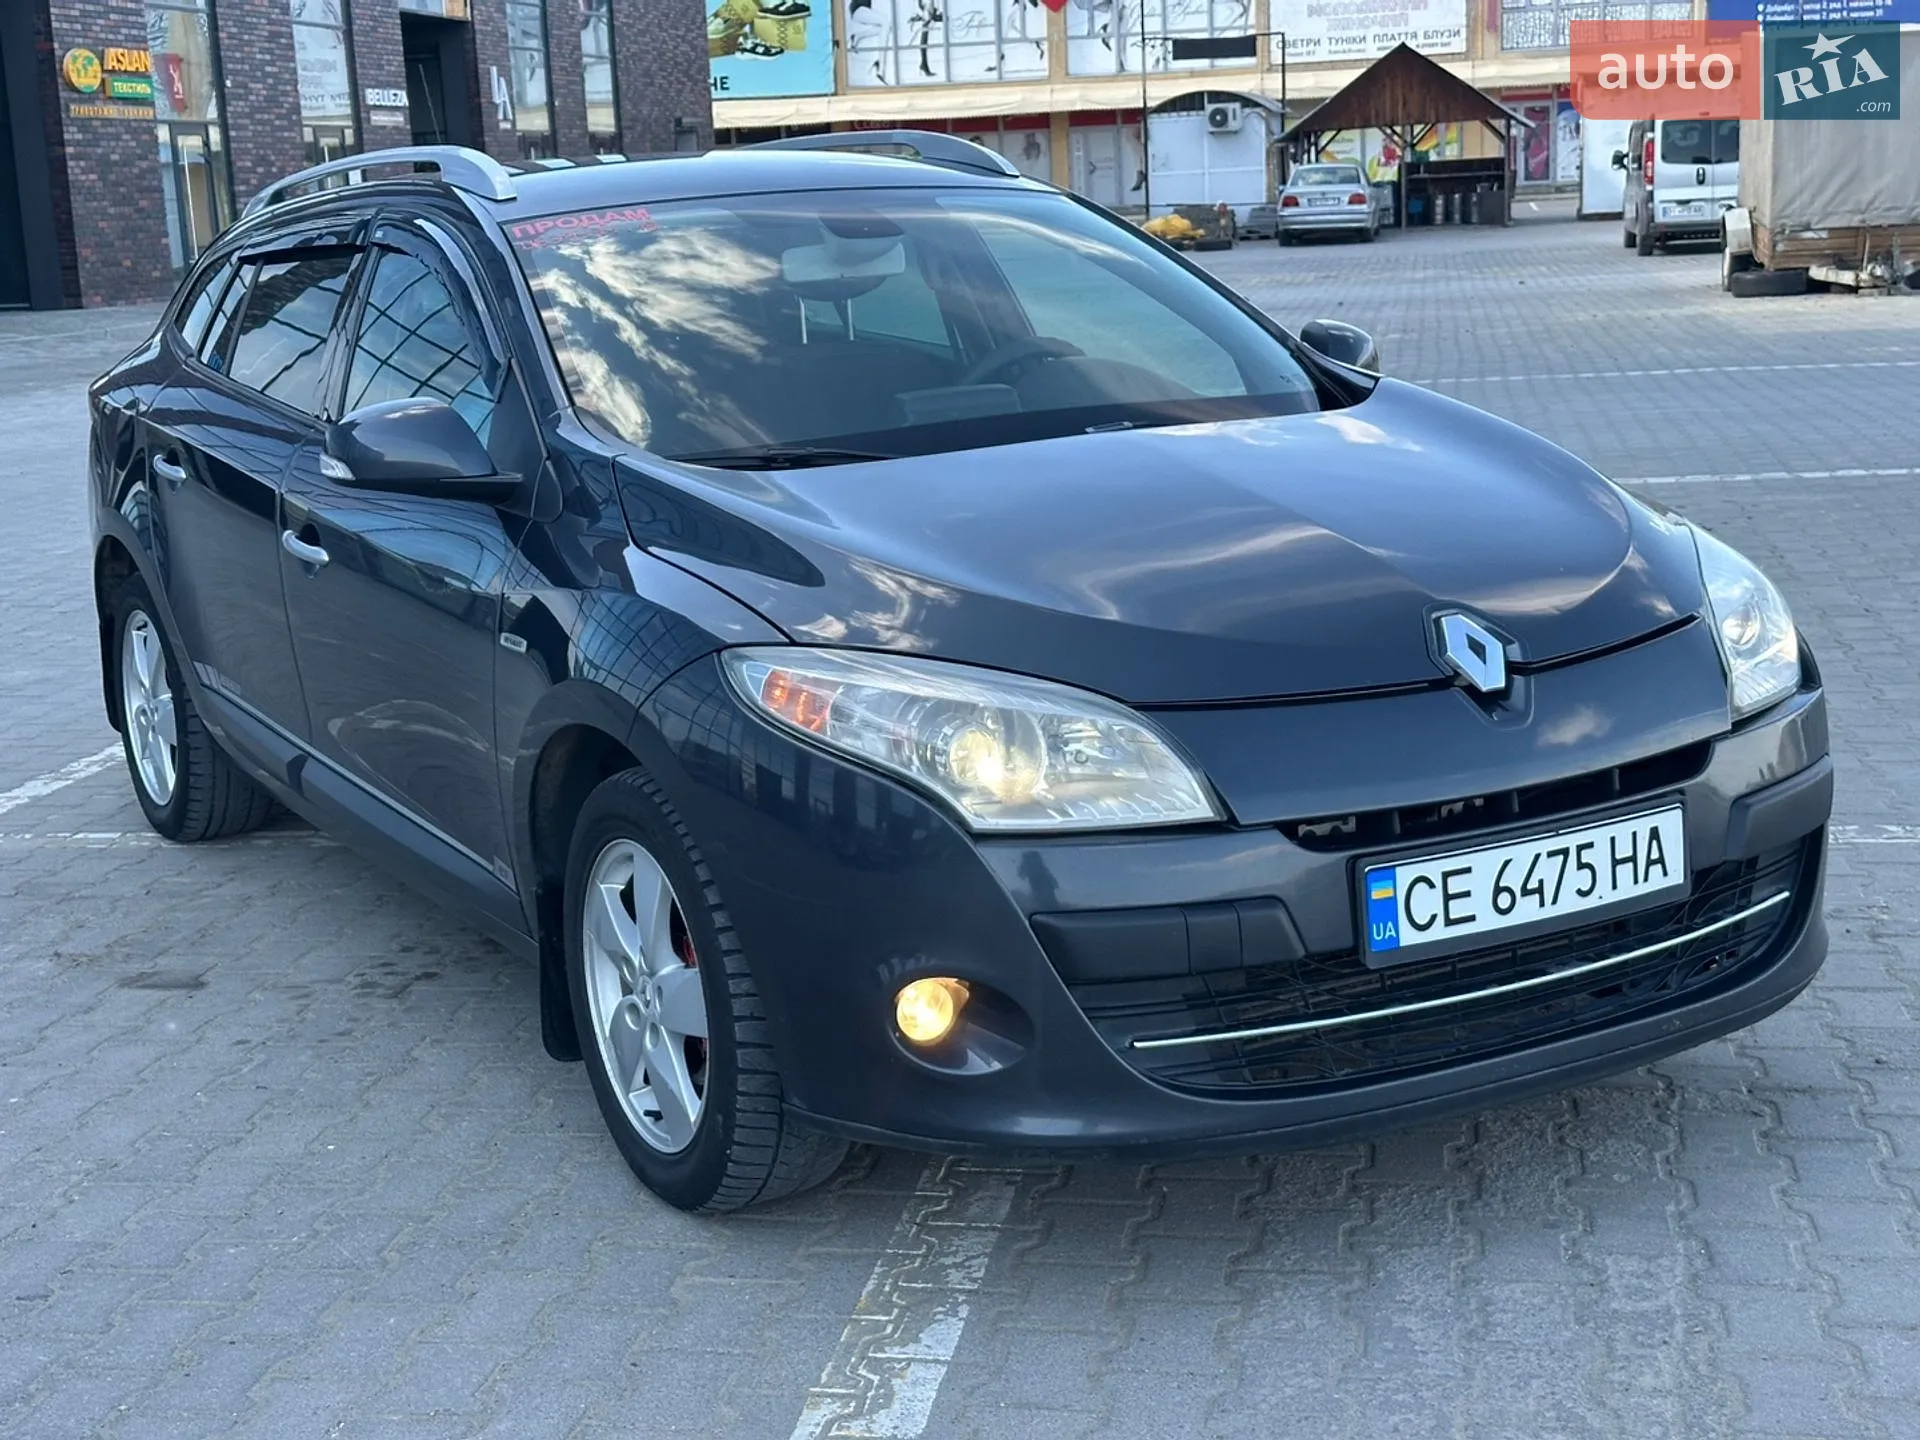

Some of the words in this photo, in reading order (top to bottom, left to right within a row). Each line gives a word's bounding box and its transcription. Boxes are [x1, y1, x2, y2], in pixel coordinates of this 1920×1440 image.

[1327, 34, 1367, 46] ТУНІКИ
[1373, 30, 1418, 44] ПЛАТТЯ
[1424, 27, 1461, 40] БЛУЗИ
[104, 47, 153, 72] ASLAN
[365, 88, 409, 107] BELLEZA
[511, 207, 650, 239] ПРОДАМ
[1404, 866, 1477, 933] CE
[1491, 841, 1598, 916] 6475
[1610, 825, 1669, 891] HA
[1372, 921, 1397, 941] UA
